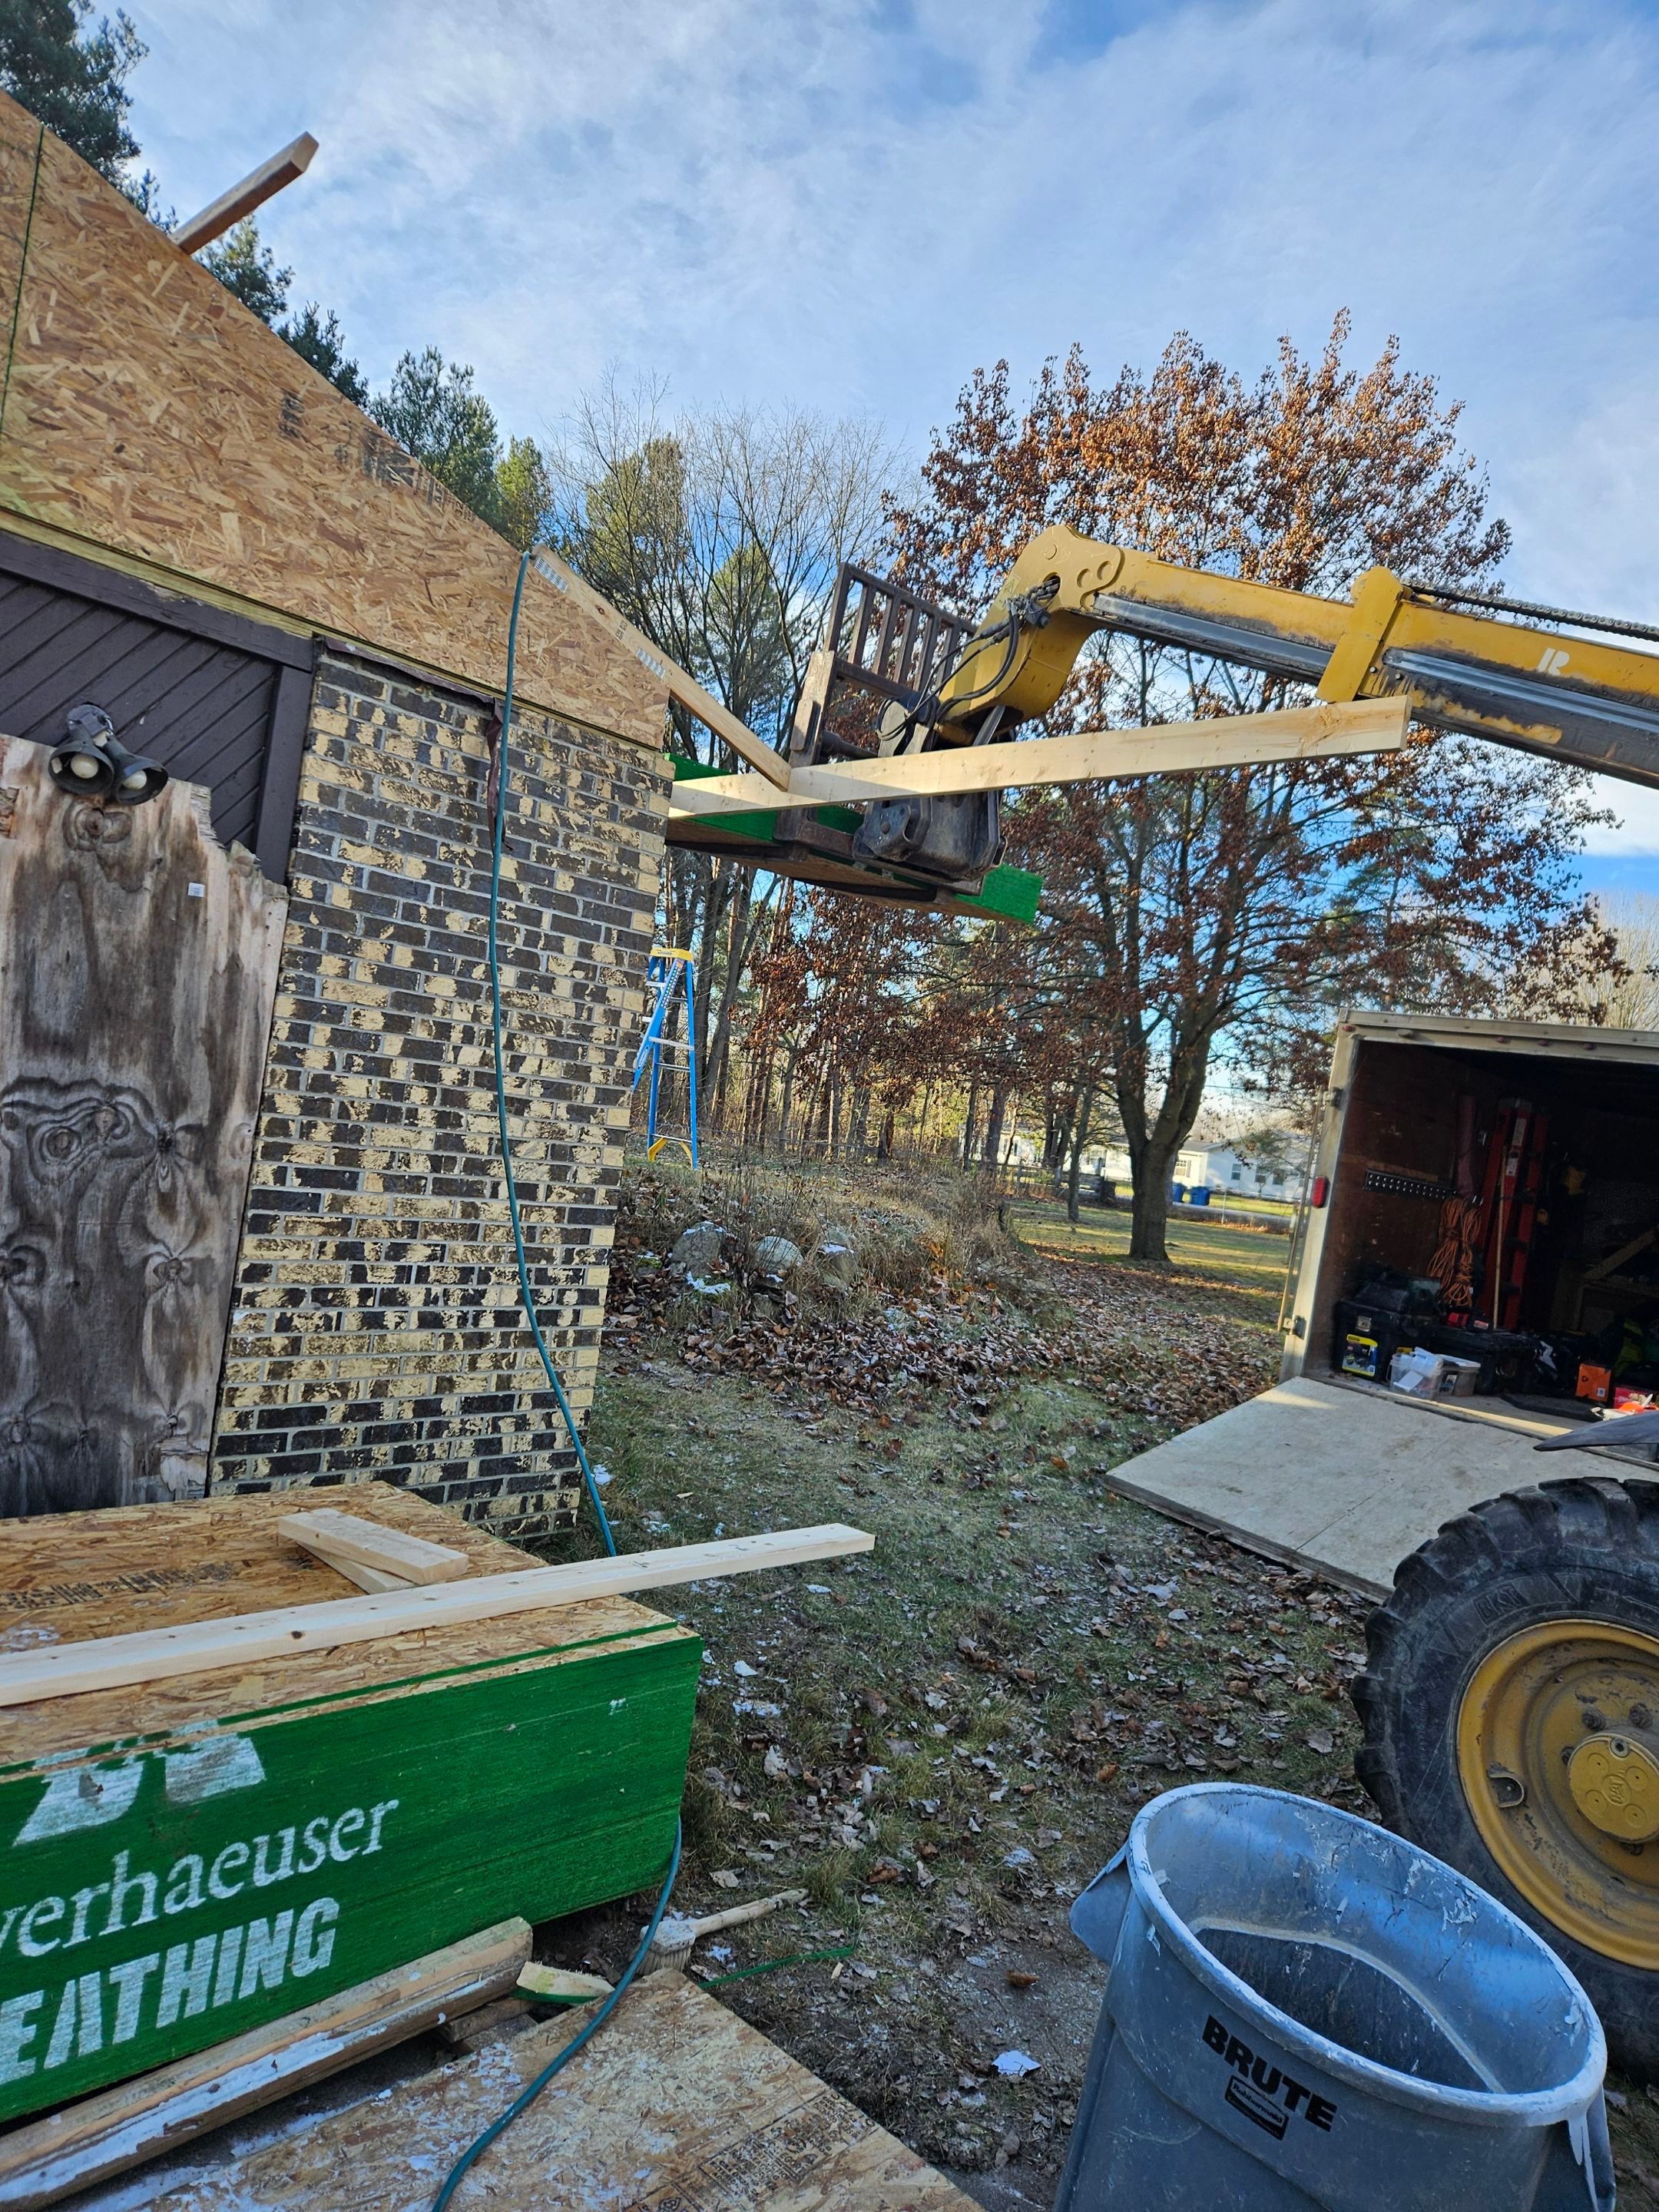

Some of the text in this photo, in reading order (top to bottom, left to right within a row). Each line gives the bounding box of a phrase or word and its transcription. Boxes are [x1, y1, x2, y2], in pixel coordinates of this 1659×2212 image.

[1475, 1585, 1522, 1622] BKT
[0, 1897, 339, 2085] EATHING
[1202, 2014, 1338, 2133] BRUTE
